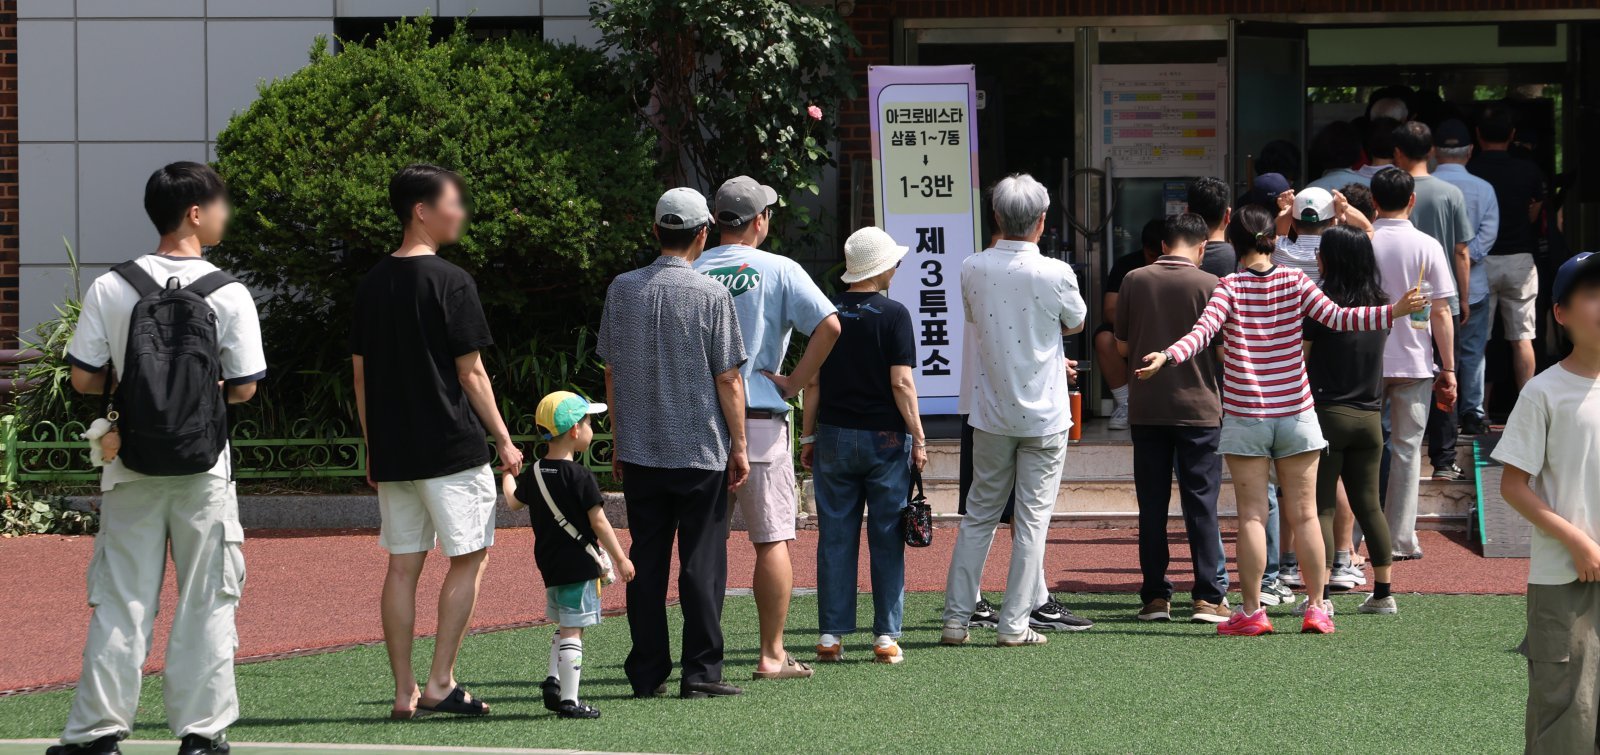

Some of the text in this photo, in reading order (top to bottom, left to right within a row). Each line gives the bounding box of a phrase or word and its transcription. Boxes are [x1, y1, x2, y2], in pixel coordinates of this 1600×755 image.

[886, 108, 963, 124] 아크로비스타
[891, 130, 960, 146] 삼풍 1~7동
[900, 174, 954, 198] 1-3반
[915, 227, 951, 376] 제3투표소
